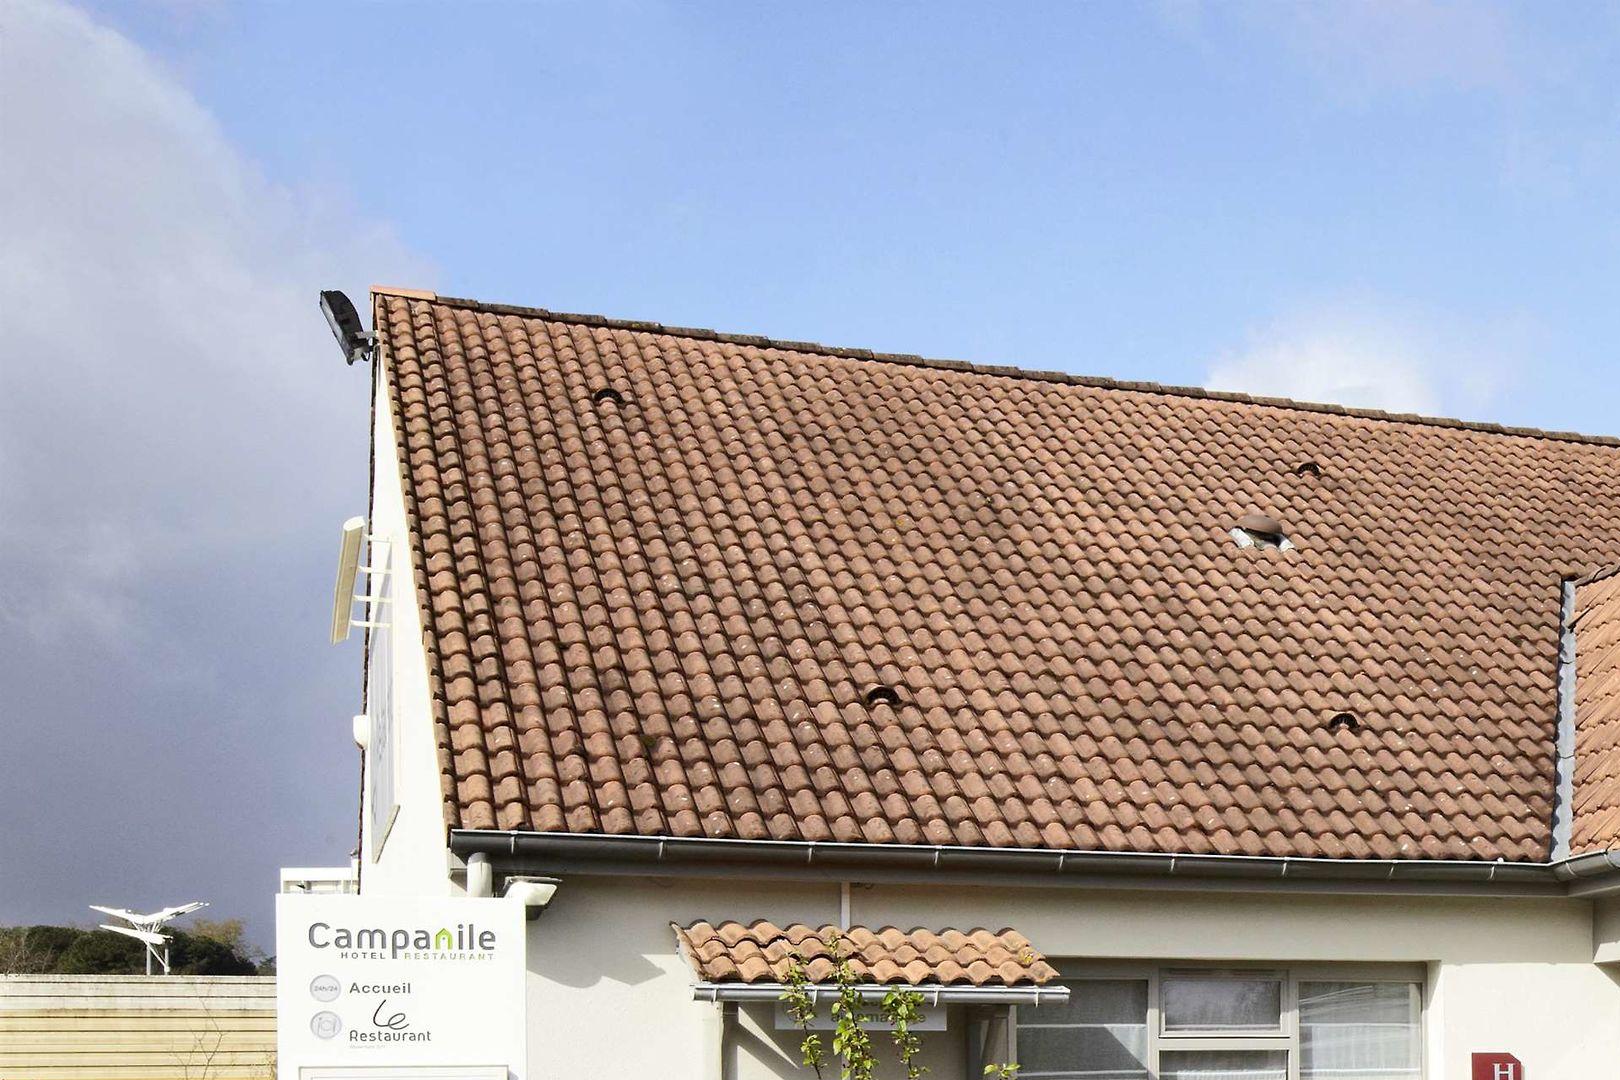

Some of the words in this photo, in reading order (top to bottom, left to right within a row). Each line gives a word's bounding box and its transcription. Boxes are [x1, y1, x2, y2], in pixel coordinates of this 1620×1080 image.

[308, 922, 496, 959] Campanile
[340, 952, 387, 960] HOTEL
[404, 952, 495, 961] RESTAURANT
[349, 982, 412, 994] Accueil
[372, 999, 410, 1031] Le
[349, 1030, 432, 1042] Restaurant
